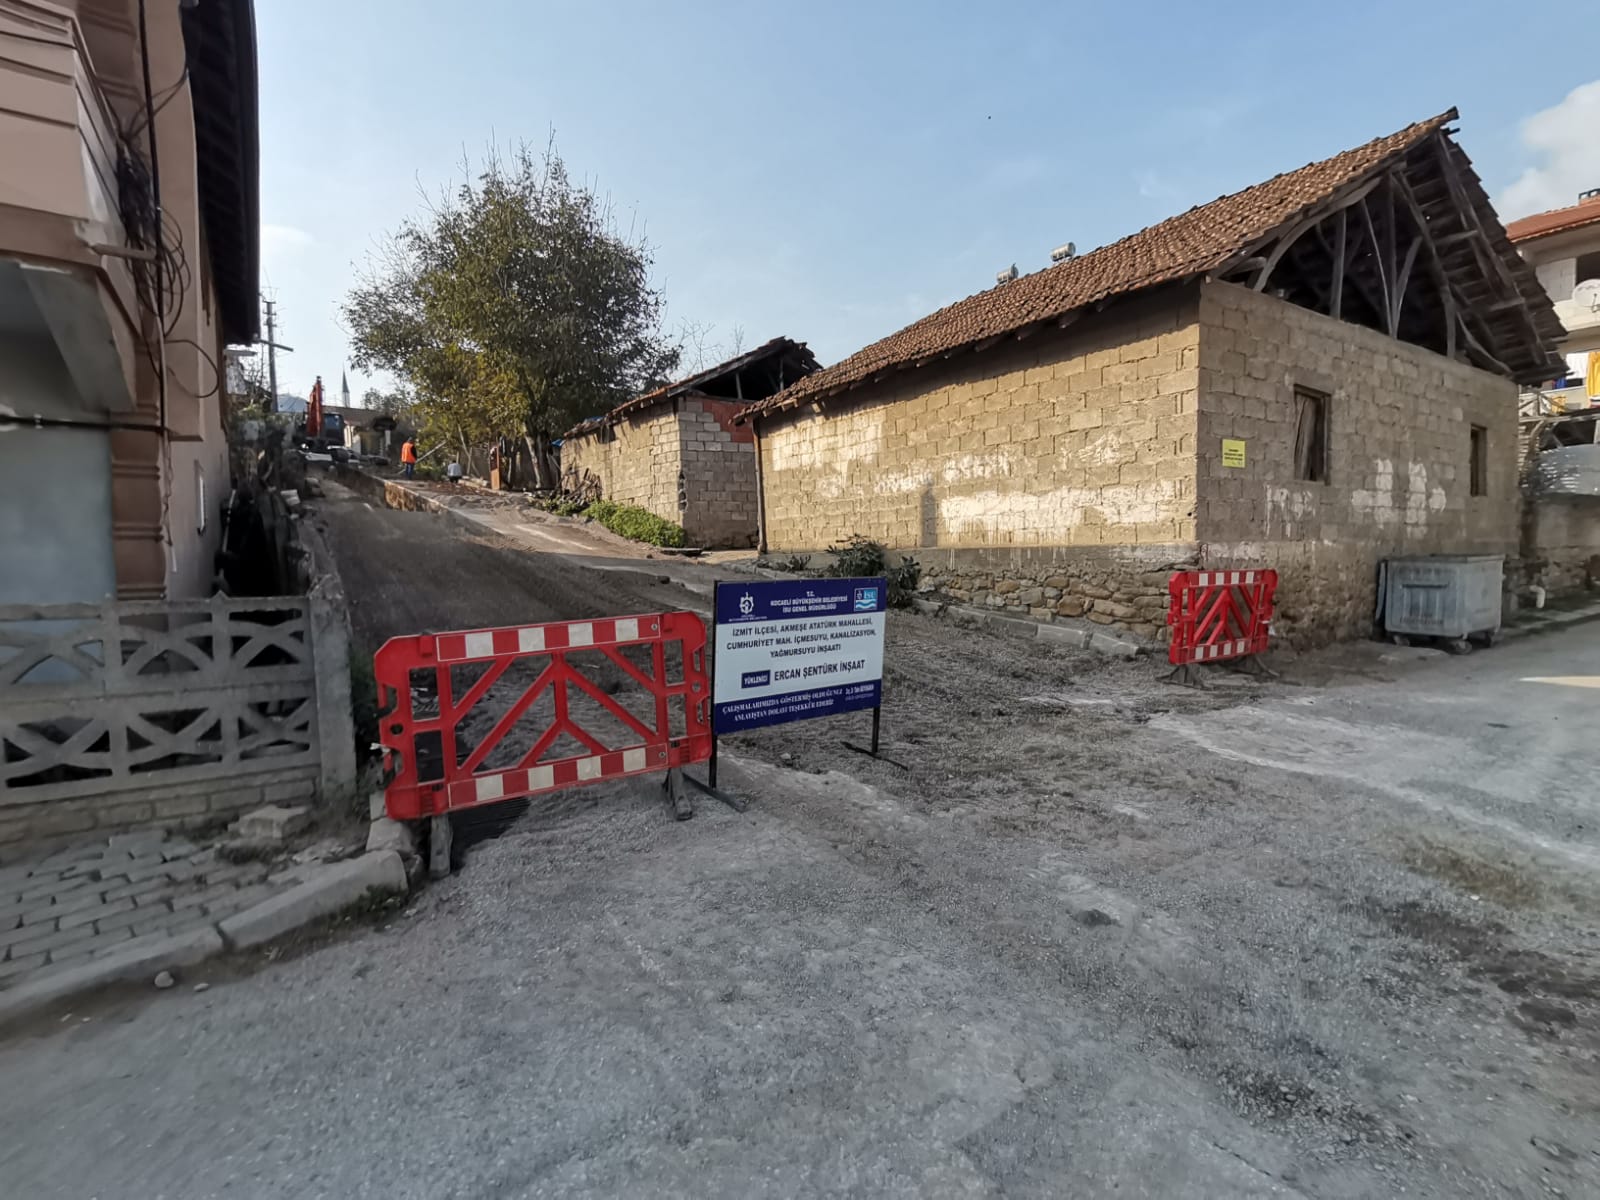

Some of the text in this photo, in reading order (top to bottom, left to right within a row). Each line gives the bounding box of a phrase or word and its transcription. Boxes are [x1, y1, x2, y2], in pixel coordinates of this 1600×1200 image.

[732, 617, 873, 637] İZMİT İLÇESİ, AKMEŞE ATATÜRK MAHALLESİ,
[726, 629, 877, 650] CUMHURİYET MAH. İÇMESUYU, KANALİZASYON,
[770, 644, 841, 658] YAĞMURSUYU İNŞAATI
[774, 668, 801, 681] ERCAN
[803, 663, 838, 679] ŞENTÜRK
[840, 659, 866, 673] İNŞAAT
